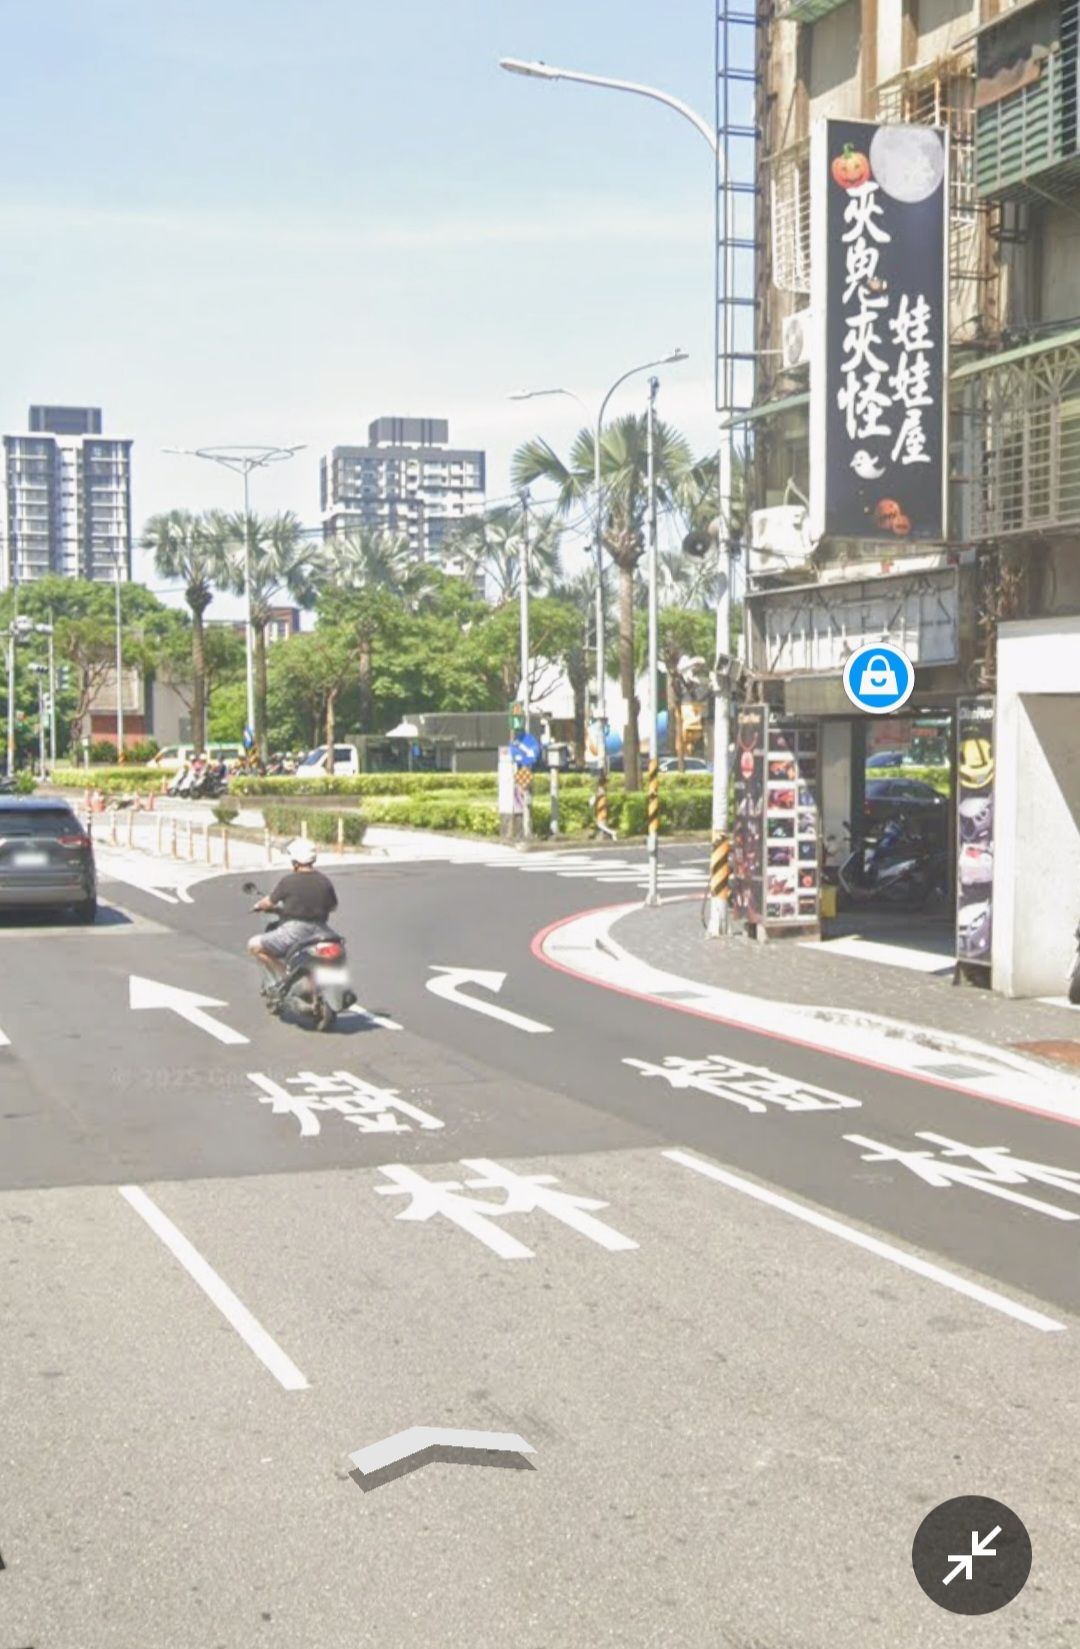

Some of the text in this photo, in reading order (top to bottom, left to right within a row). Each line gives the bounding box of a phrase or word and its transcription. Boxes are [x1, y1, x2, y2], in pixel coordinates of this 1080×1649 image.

[837, 181, 892, 439] 夾鬼夾怪
[888, 294, 934, 465] 娃娃屋
[247, 1071, 639, 1259] 樹林
